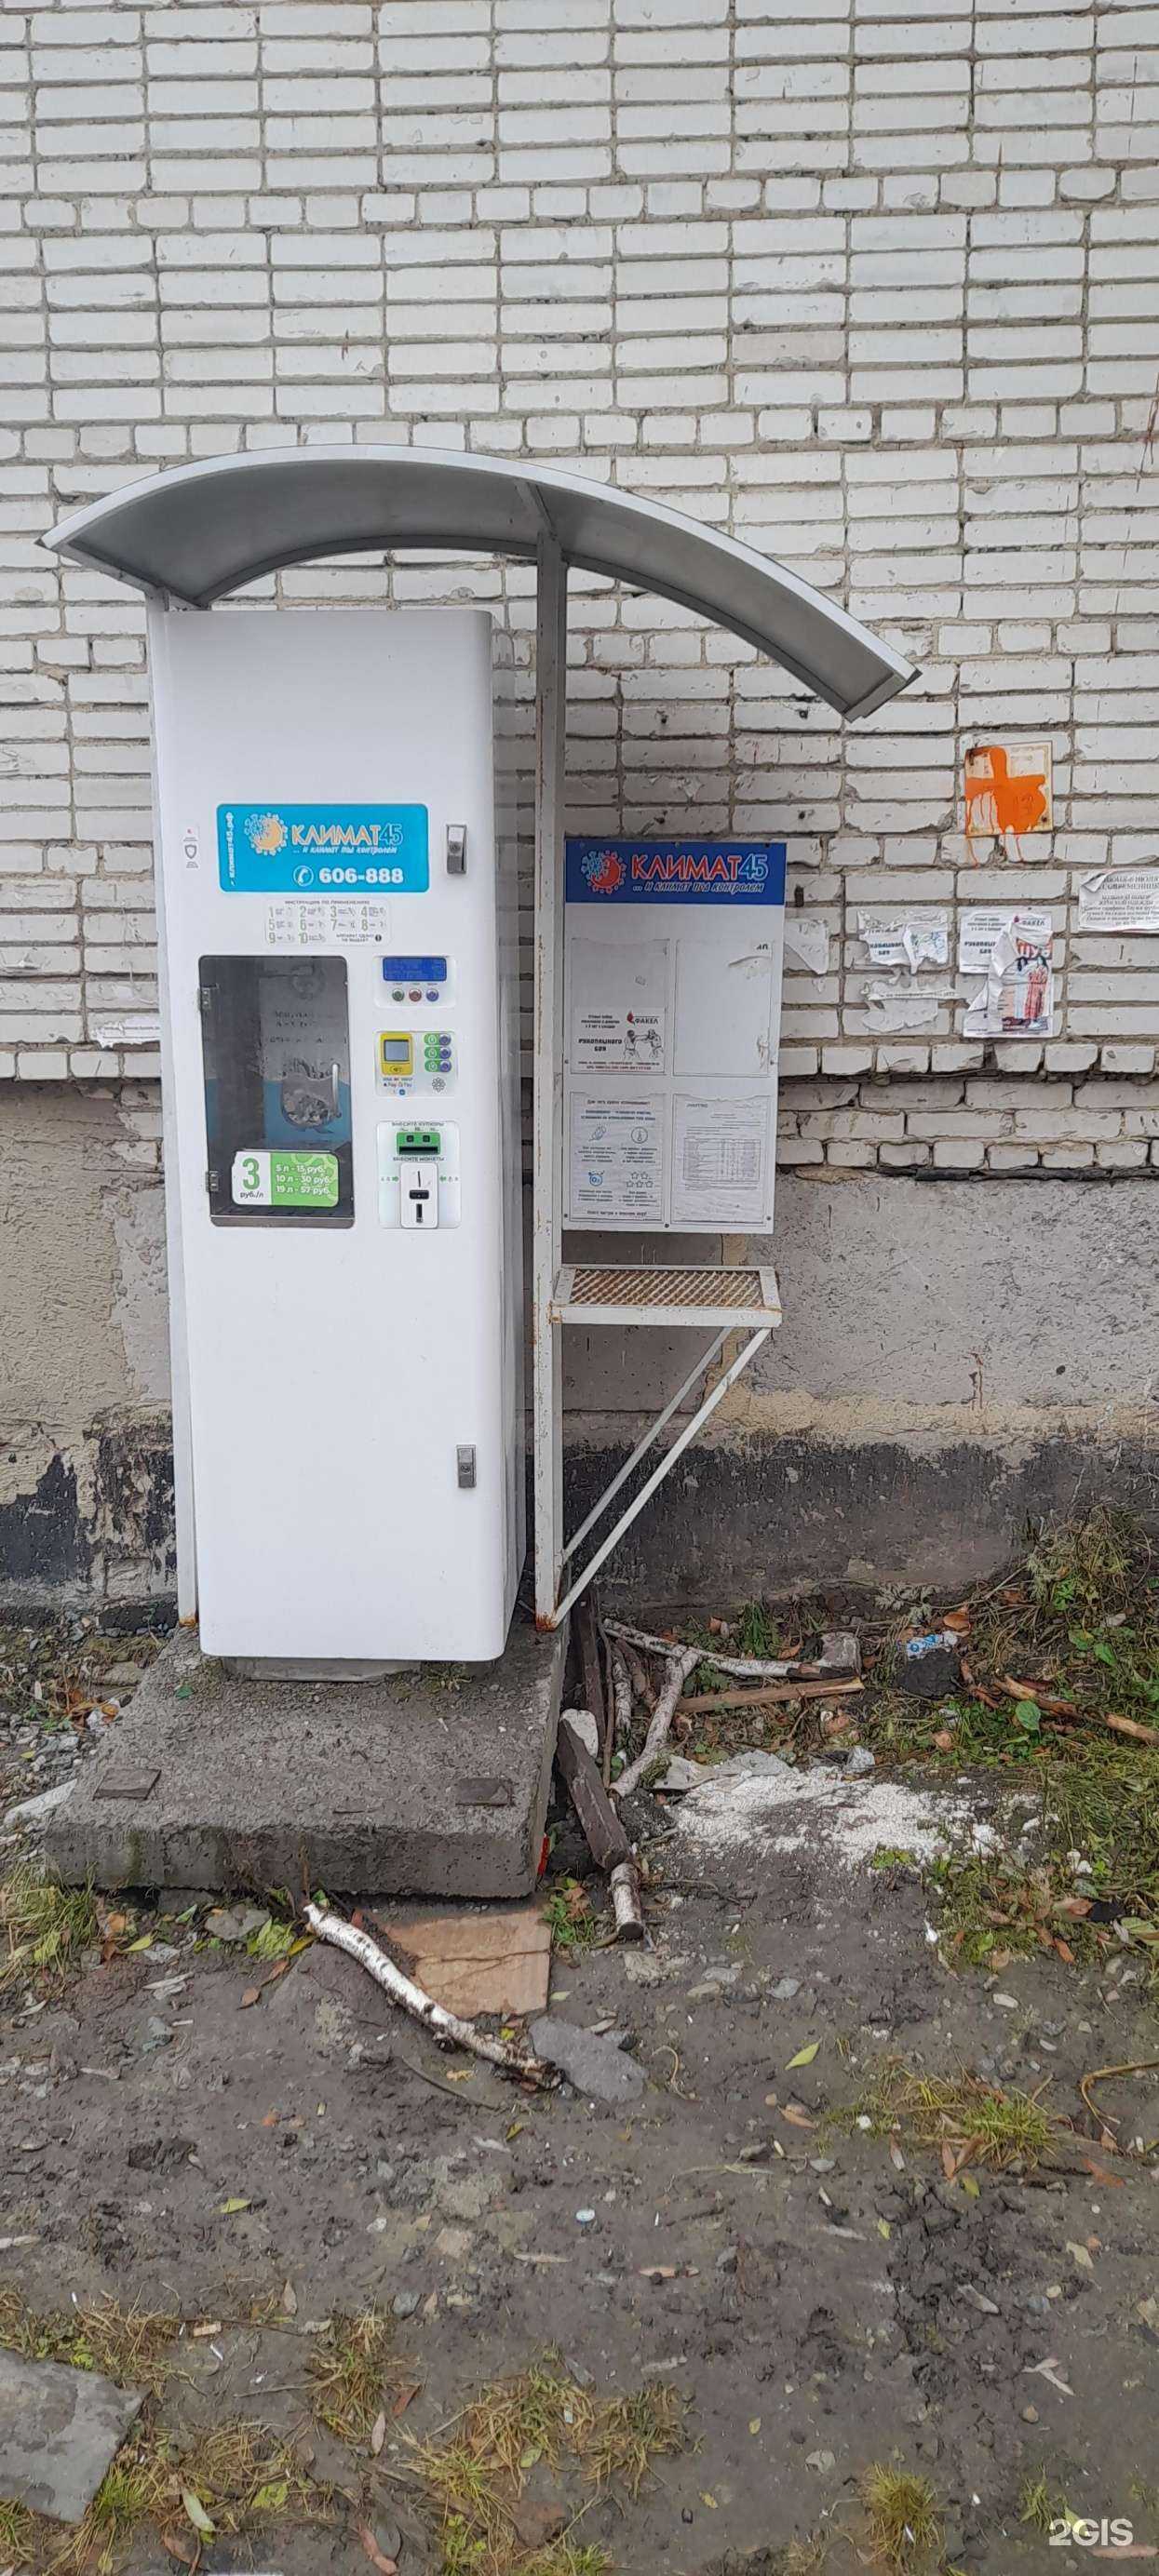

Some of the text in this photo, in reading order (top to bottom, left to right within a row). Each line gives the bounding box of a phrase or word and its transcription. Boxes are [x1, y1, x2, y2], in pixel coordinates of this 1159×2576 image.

[291, 824, 403, 846] КЛИМАТ45
[631, 853, 769, 880] КЛИМАТ45
[319, 867, 404, 884] 606-888
[300, 906, 306, 918] 2
[330, 906, 337, 918] 3
[361, 906, 368, 918] 4
[269, 919, 275, 931] 5
[330, 919, 337, 931] 7
[361, 919, 369, 931] 8
[269, 932, 276, 944] 9
[242, 1158, 260, 1190] 3
[276, 1164, 282, 1173] 5
[276, 1174, 286, 1183] 10
